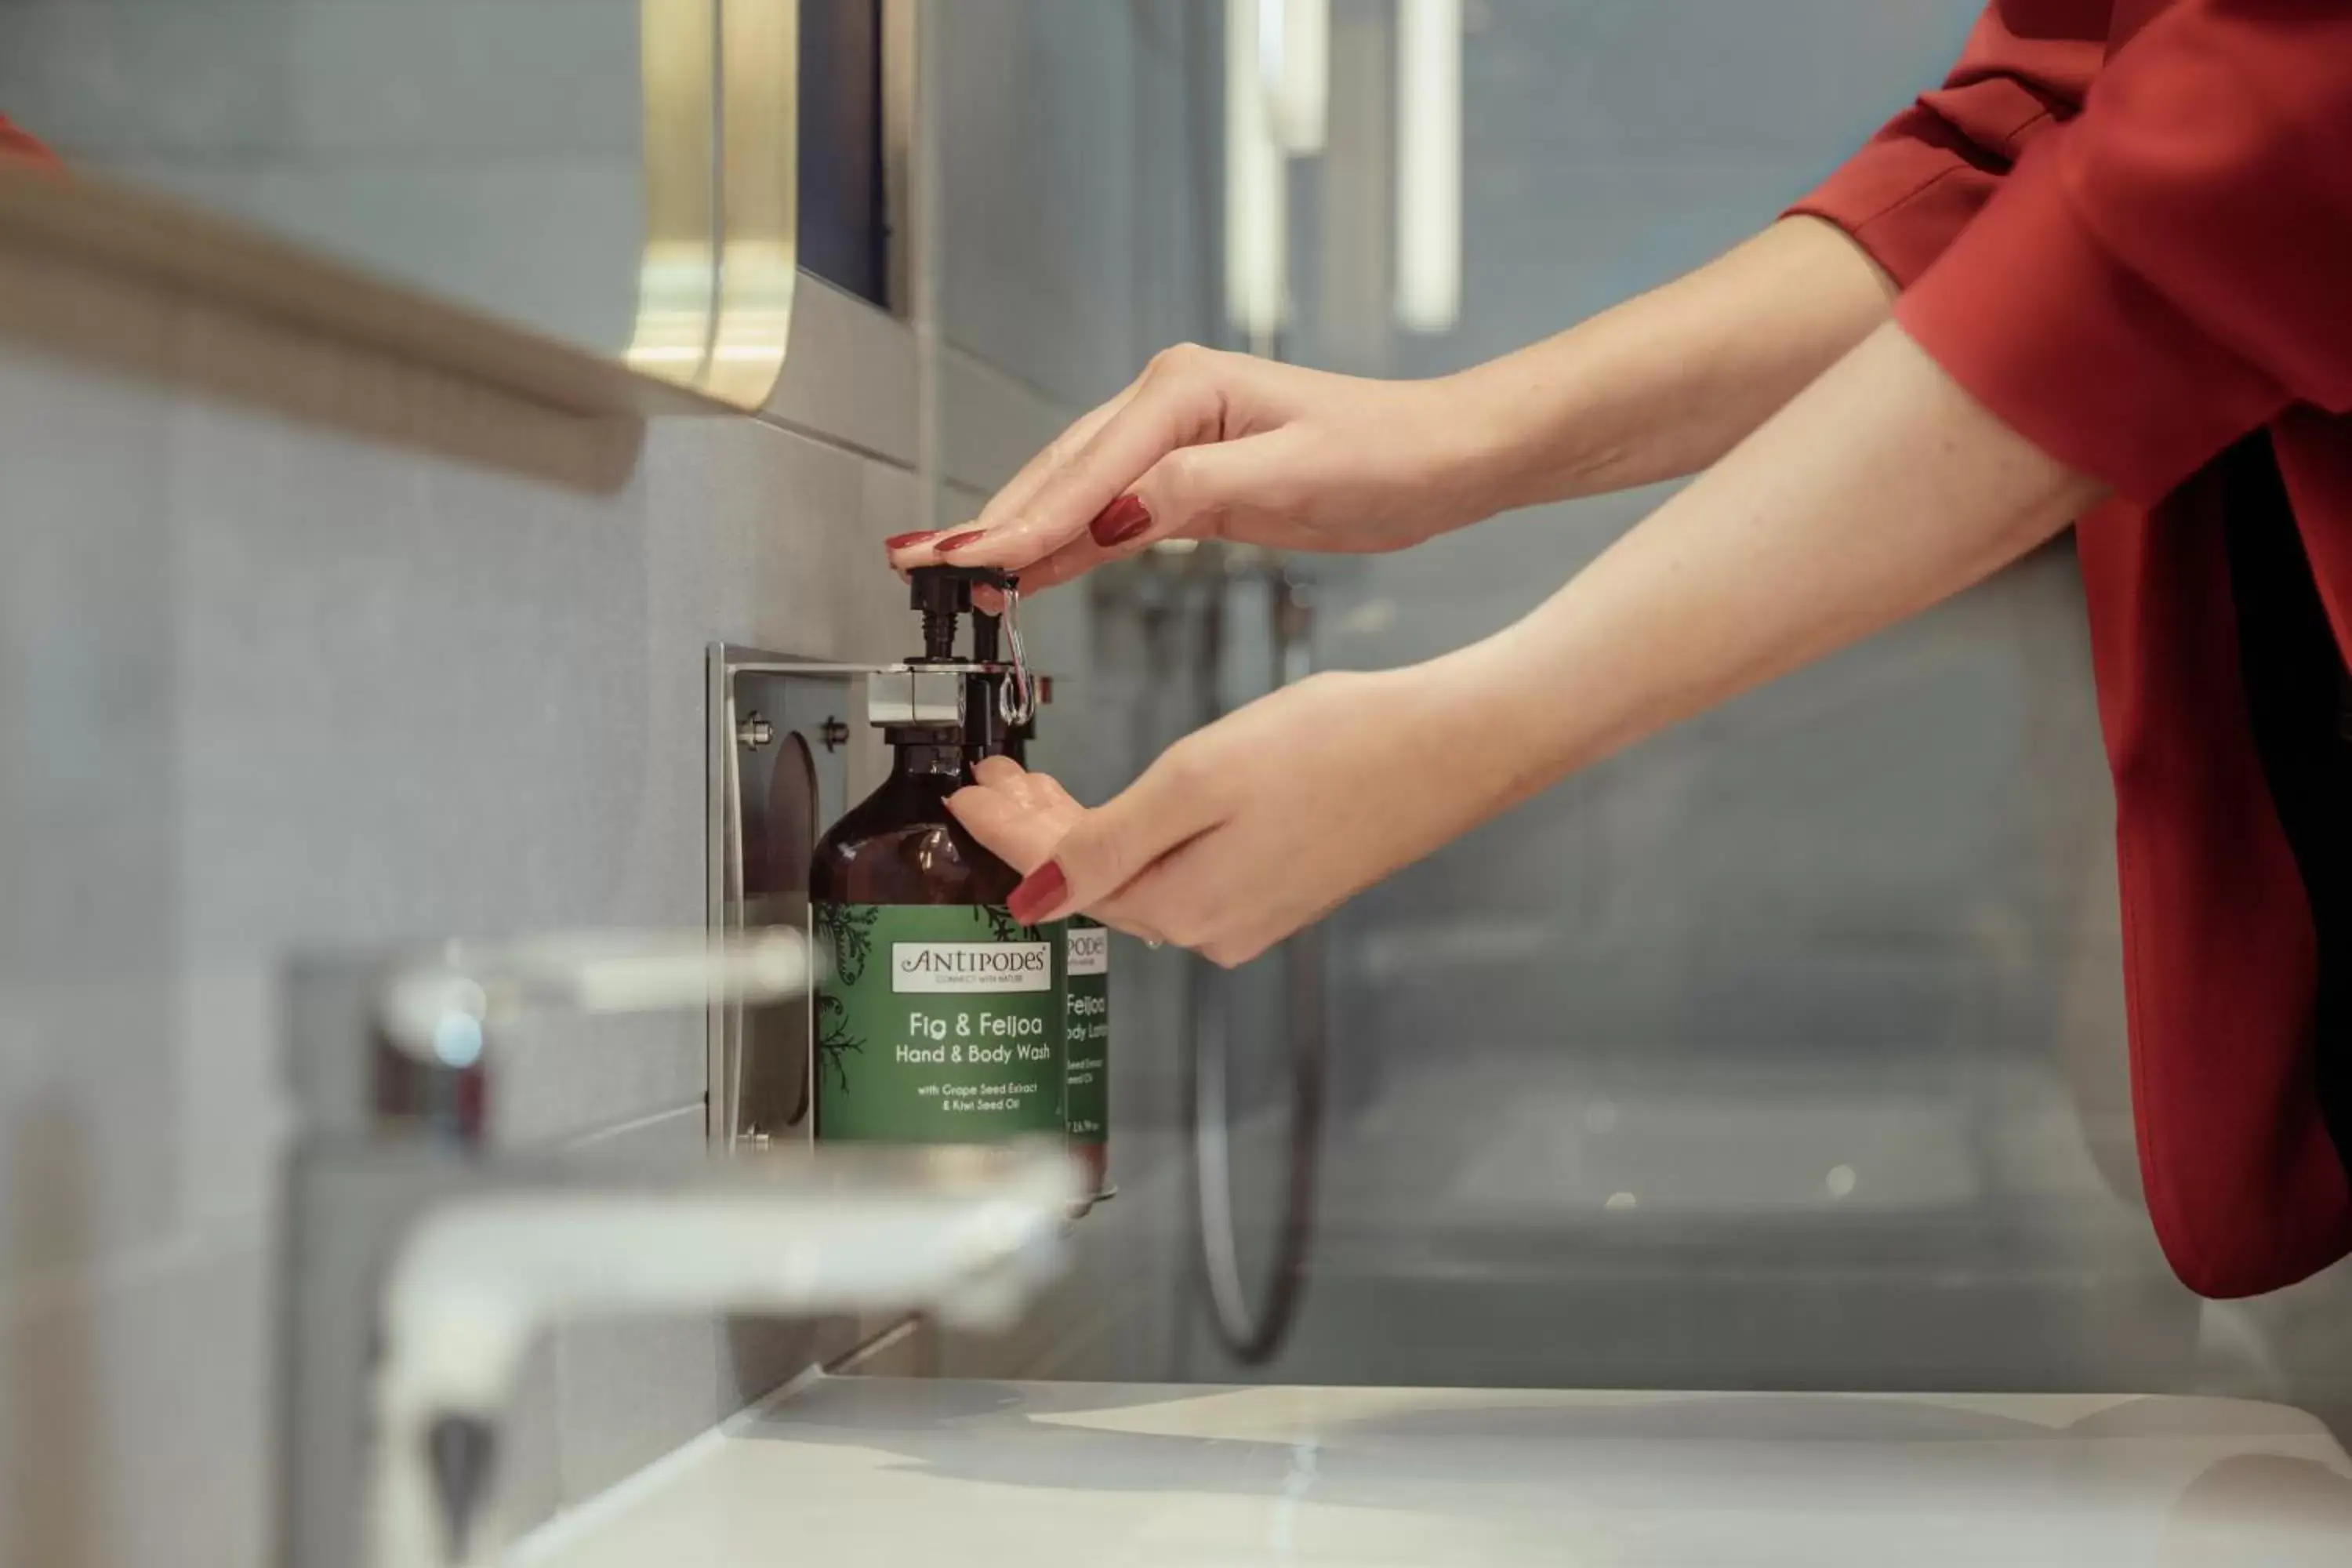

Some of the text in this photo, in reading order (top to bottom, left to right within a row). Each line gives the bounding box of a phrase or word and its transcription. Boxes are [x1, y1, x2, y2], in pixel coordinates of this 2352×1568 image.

[909, 1011, 1042, 1040] Fig & Feijoa
[896, 1042, 1051, 1065] Hand & Body Wash
[918, 1082, 1037, 1098] with Grape Seed Extract
[942, 1098, 1020, 1111] & Kiwi Seed Oil
